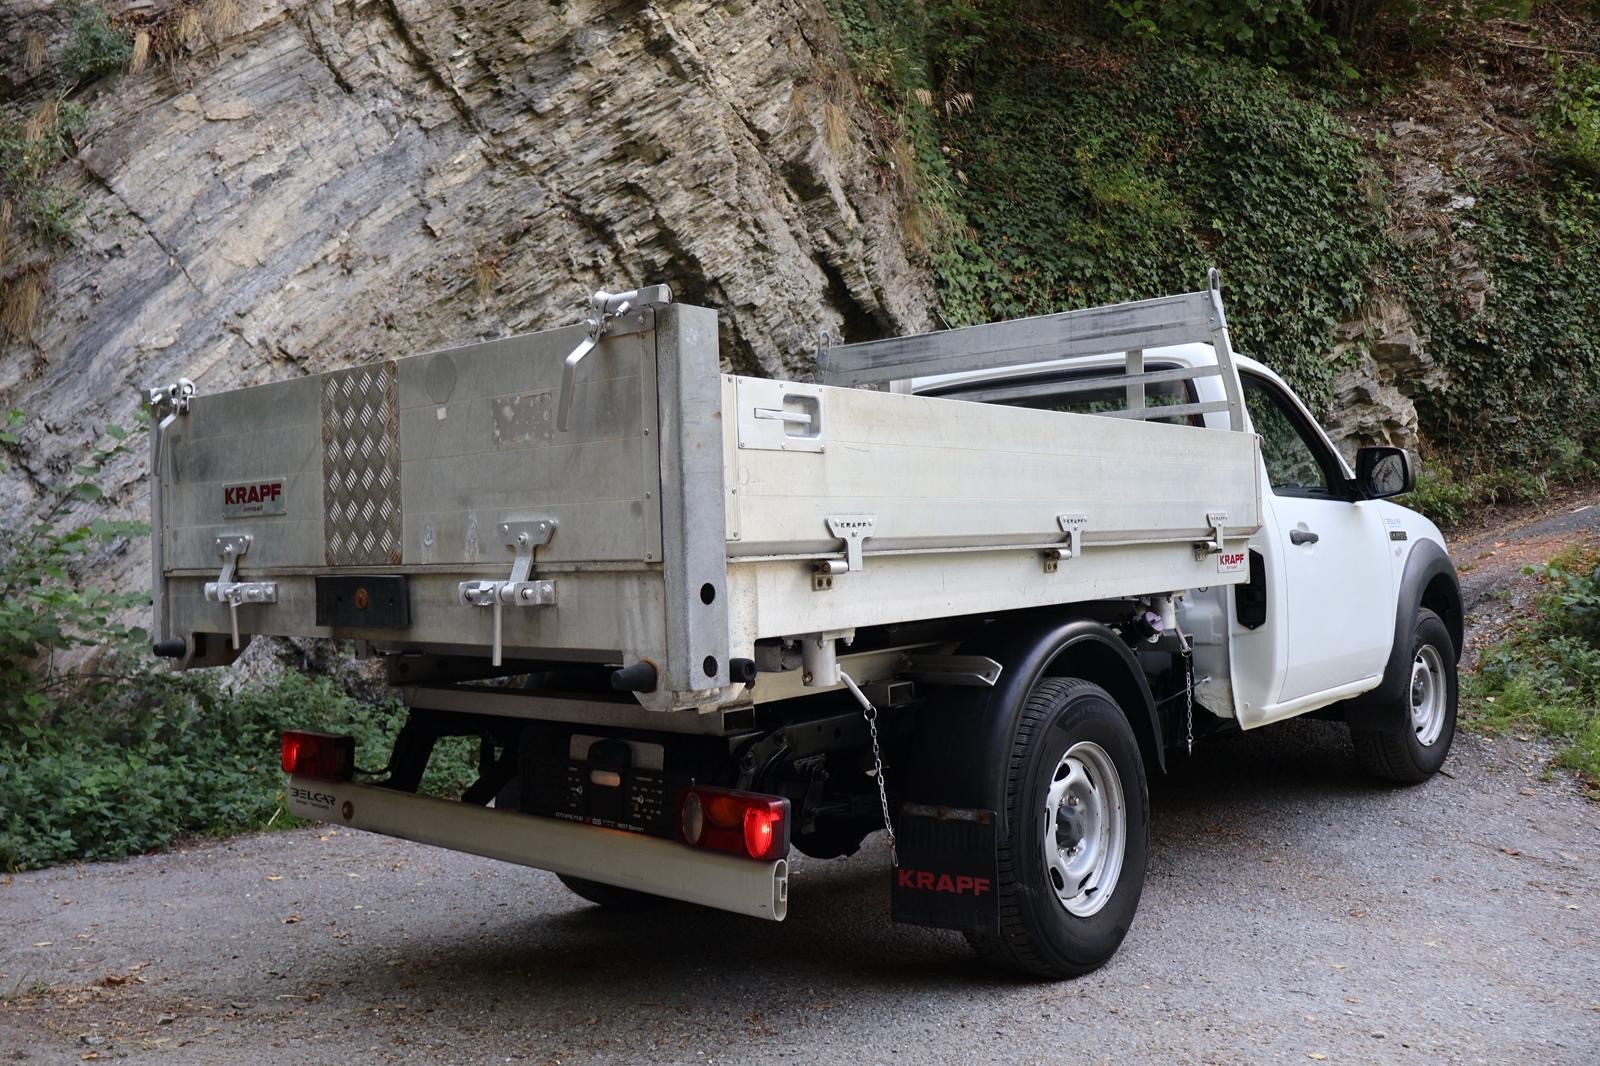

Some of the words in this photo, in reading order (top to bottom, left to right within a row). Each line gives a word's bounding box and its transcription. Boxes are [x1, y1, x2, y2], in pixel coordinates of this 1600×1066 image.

[225, 483, 282, 505] KRAPF
[1219, 553, 1245, 566] KRAPF
[290, 786, 336, 806] BELCAR
[899, 869, 991, 896] KRAPF
